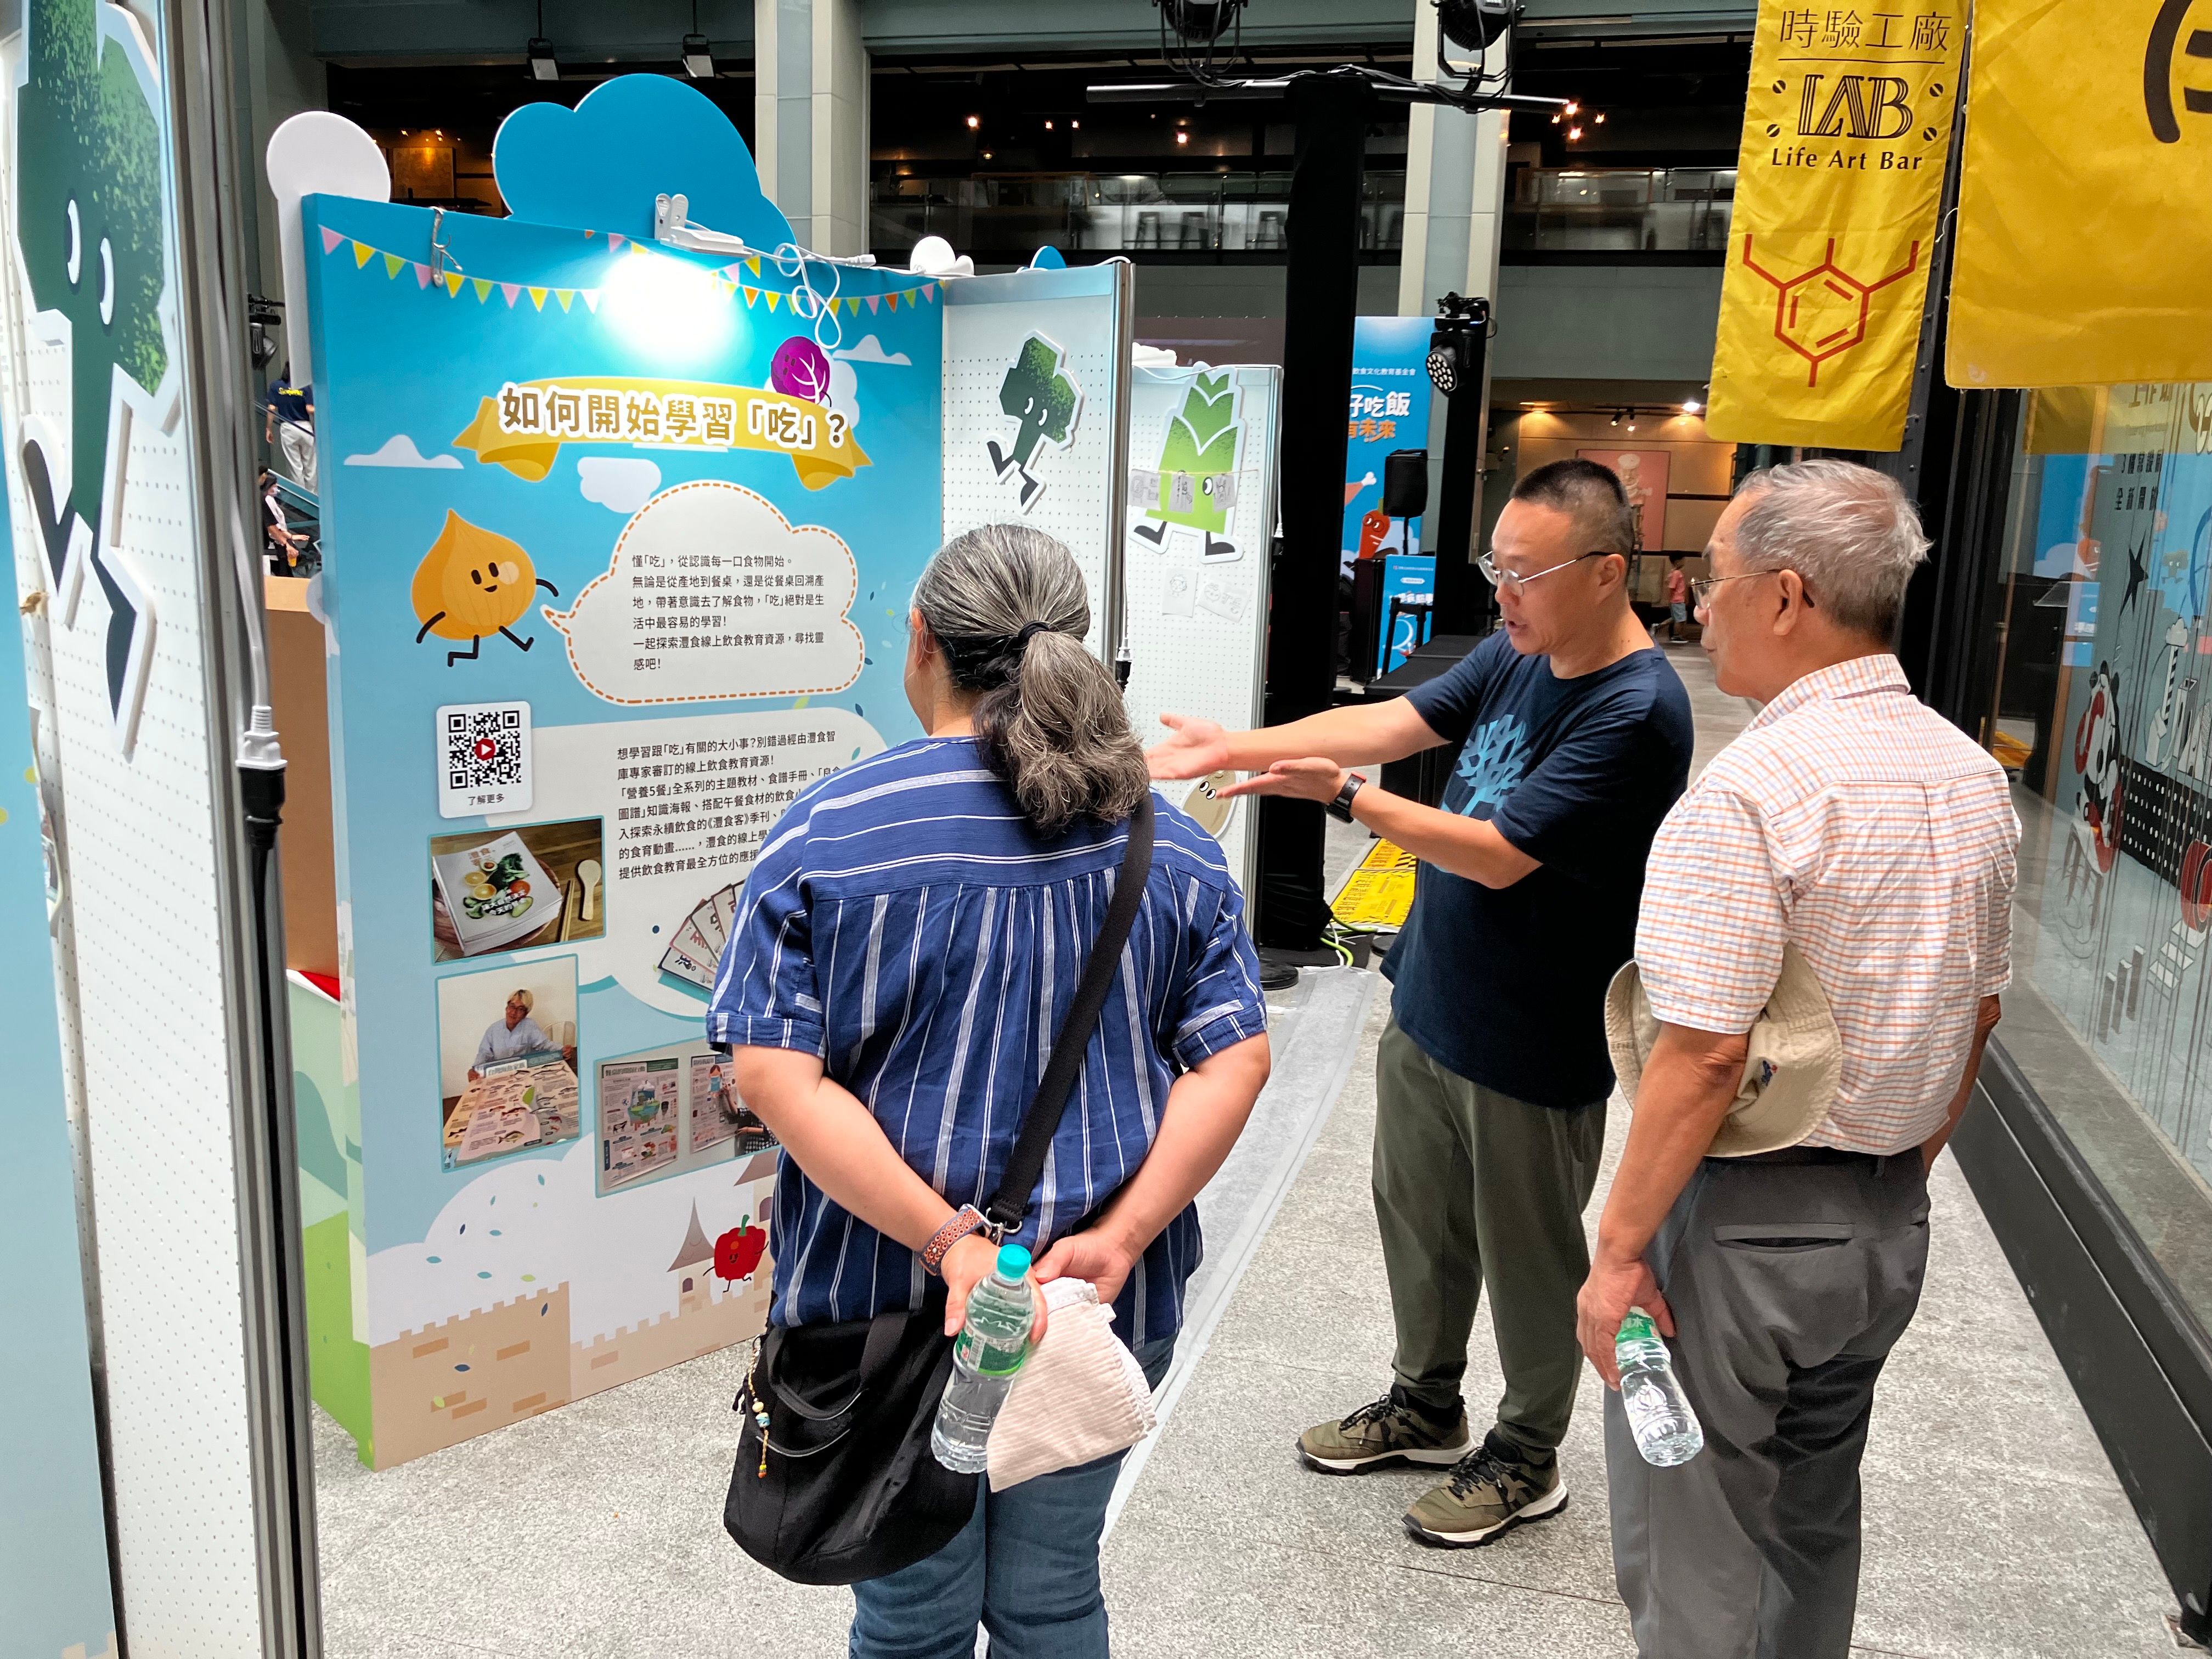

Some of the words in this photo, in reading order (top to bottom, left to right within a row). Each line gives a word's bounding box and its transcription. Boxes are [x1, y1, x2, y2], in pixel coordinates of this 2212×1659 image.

[1780, 8, 1952, 51] 時驗工廠
[1798, 74, 1913, 139] LAB
[1772, 146, 1818, 167] Life
[1828, 150, 1867, 170] Art
[1880, 151, 1922, 170] Bar
[503, 388, 845, 445] 如何開始學習「吃」？
[467, 793, 505, 806] 了解更多
[619, 809, 785, 839] 入探索永續飲食的《灃食客》季刊、
